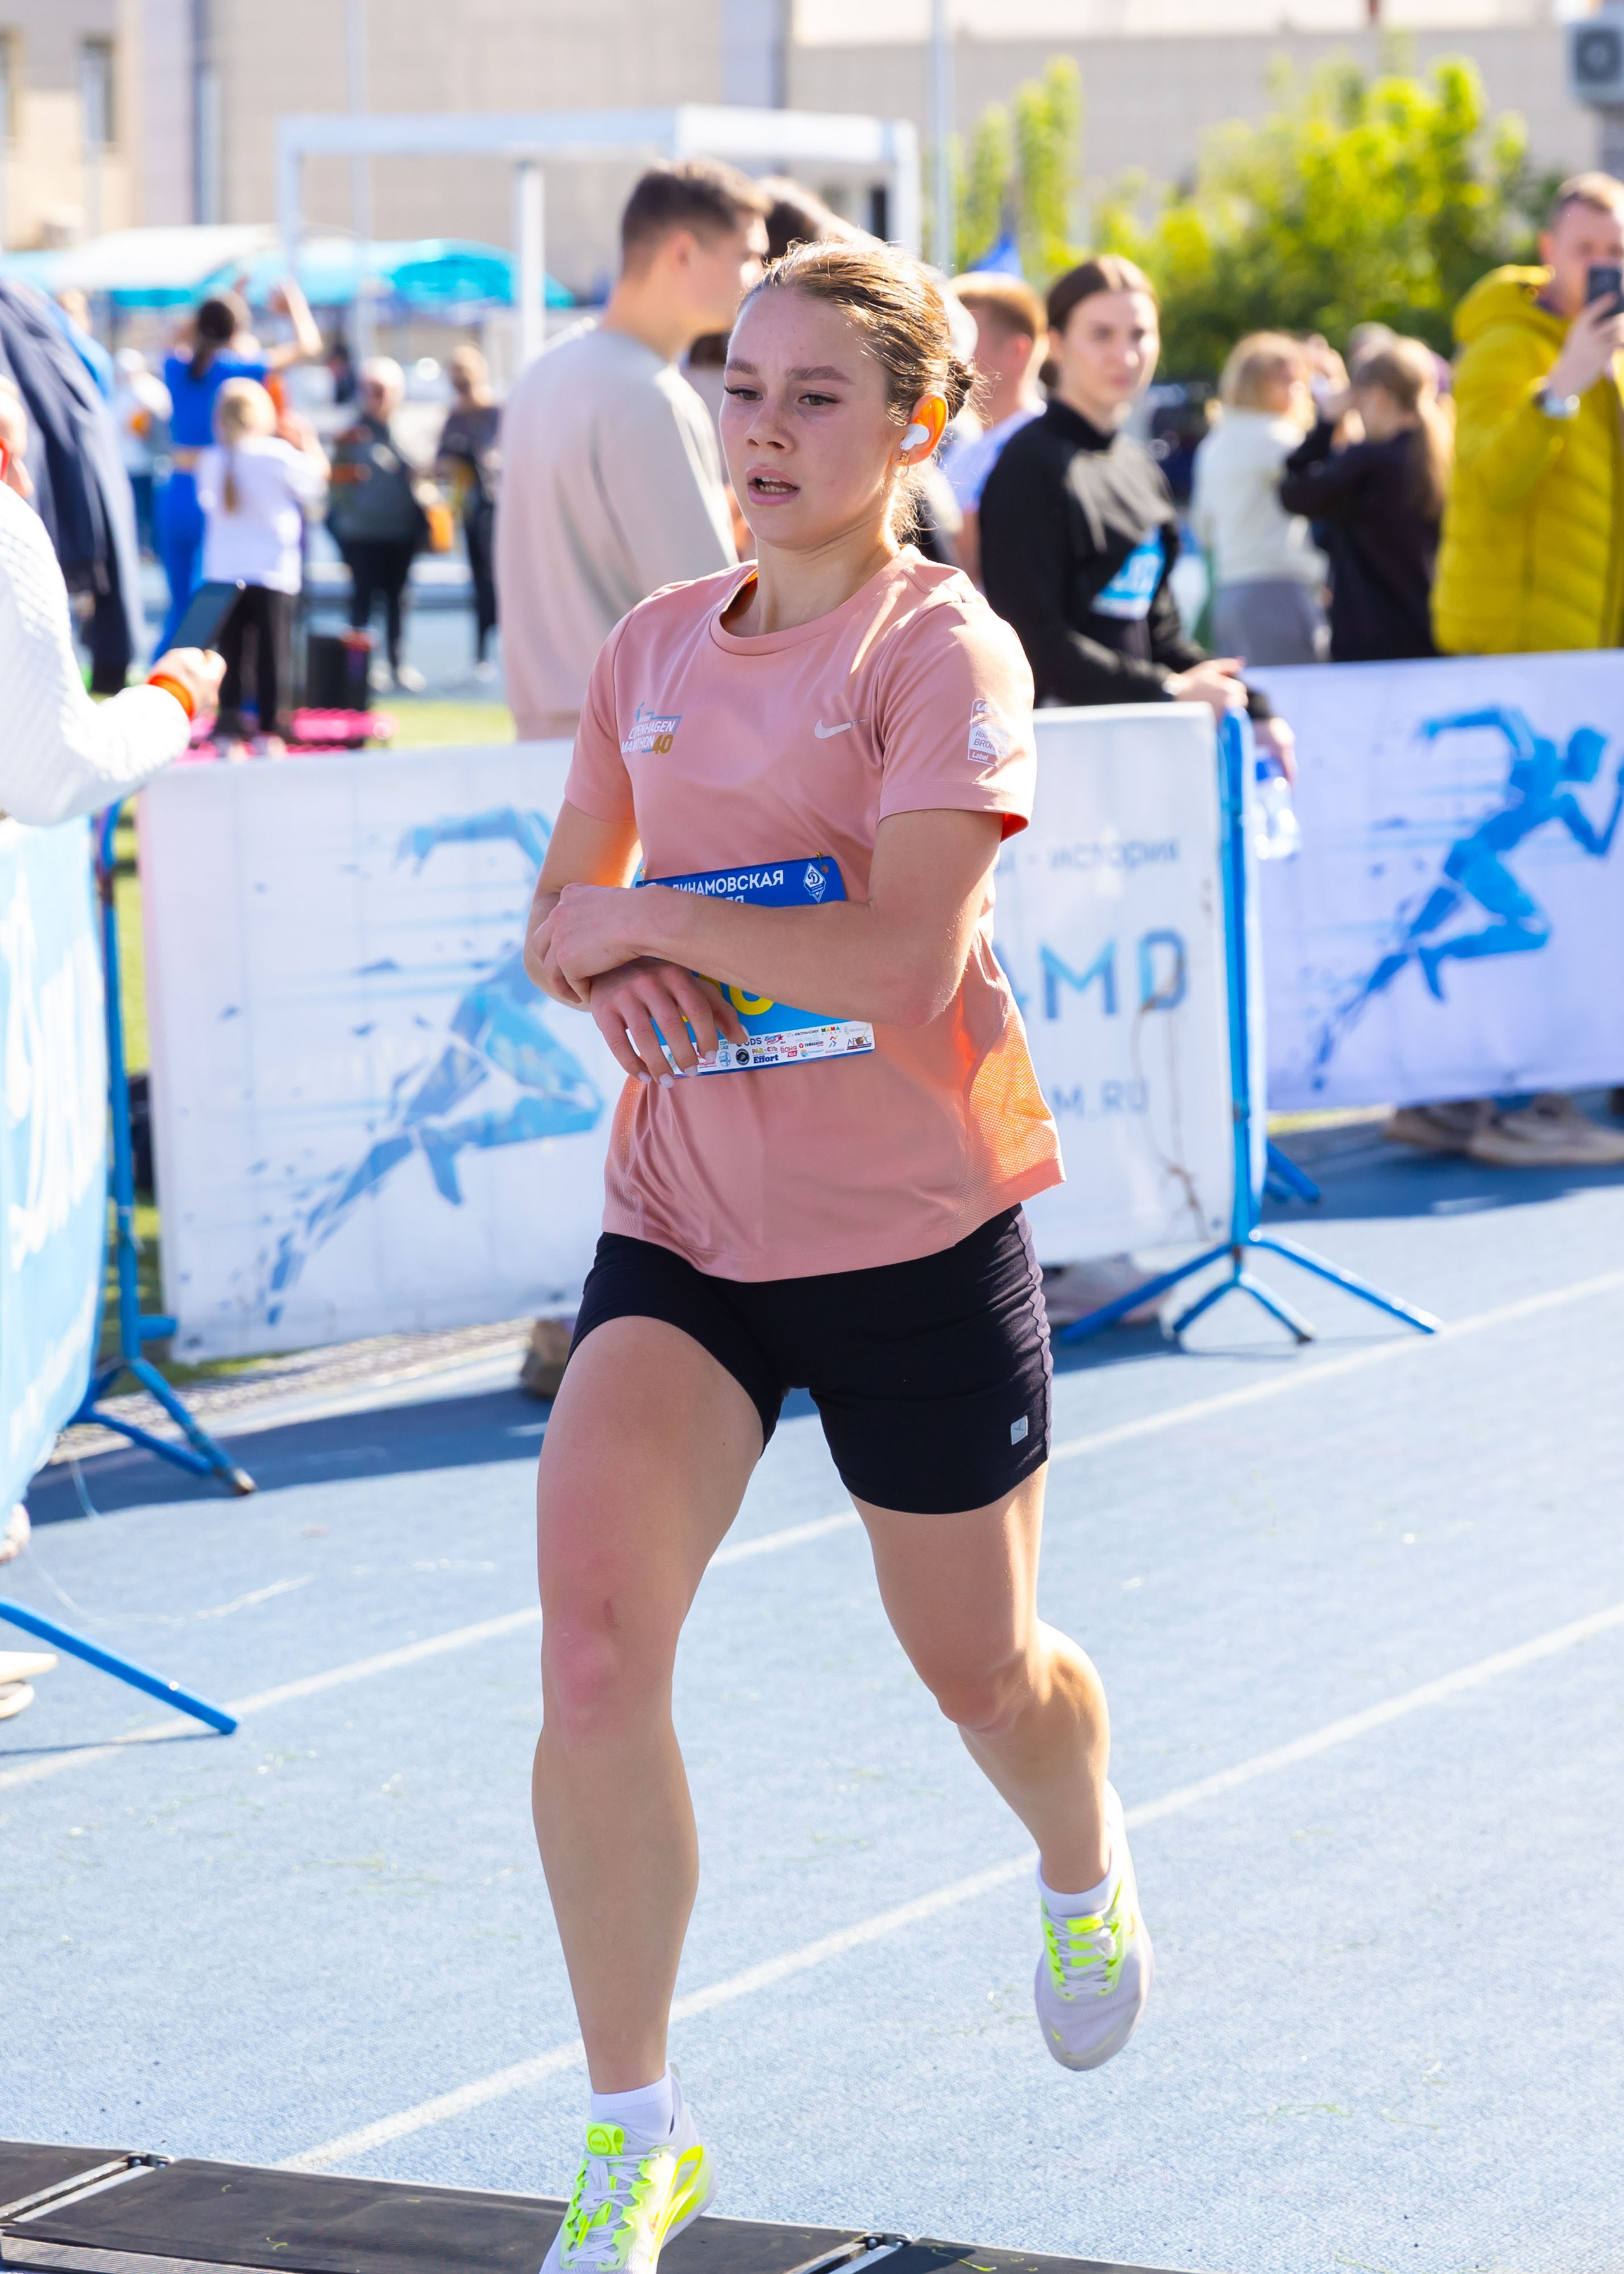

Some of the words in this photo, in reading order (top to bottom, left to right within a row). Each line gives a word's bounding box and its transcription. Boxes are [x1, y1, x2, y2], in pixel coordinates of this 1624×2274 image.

[628, 720, 676, 740] COPENHAGEN
[620, 735, 655, 754] MARATHON
[652, 734, 674, 754] 40
[972, 751, 988, 761] Label
[753, 1054, 779, 1064] Effort
